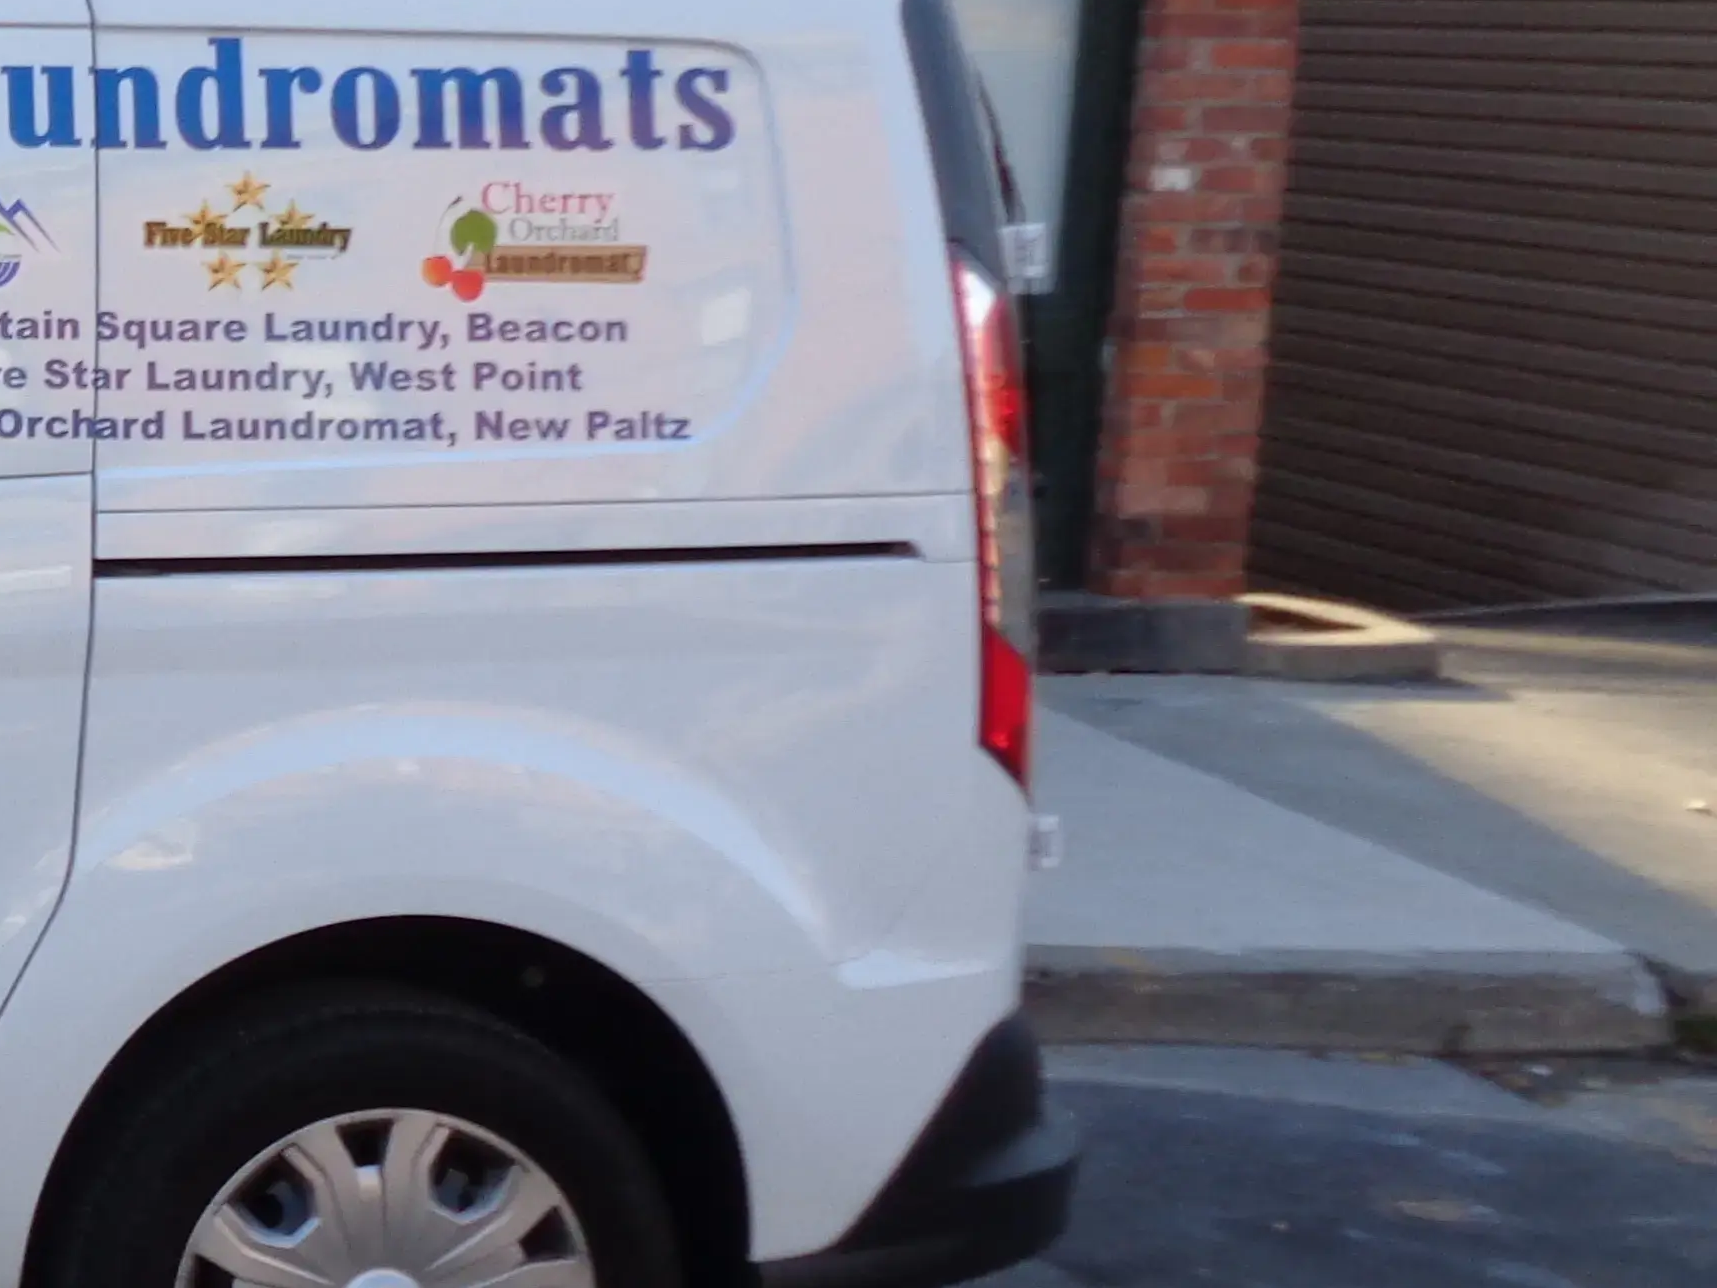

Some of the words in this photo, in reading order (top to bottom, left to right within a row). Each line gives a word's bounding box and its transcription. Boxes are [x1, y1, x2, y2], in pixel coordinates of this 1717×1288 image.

[481, 179, 616, 225] Cherry
[143, 220, 195, 249] Five
[201, 220, 252, 249] Star
[257, 220, 354, 253] Laundry
[509, 215, 620, 242] Orchard
[95, 311, 248, 349] Square
[264, 312, 452, 350] Laundry,
[467, 312, 629, 343] Beacon
[43, 359, 133, 391] Star
[145, 361, 334, 400] Laundry,
[349, 361, 457, 392] West
[473, 362, 585, 392] Point
[182, 410, 459, 447] Laundromat,
[475, 411, 571, 441] New
[586, 411, 693, 441] Paltz
